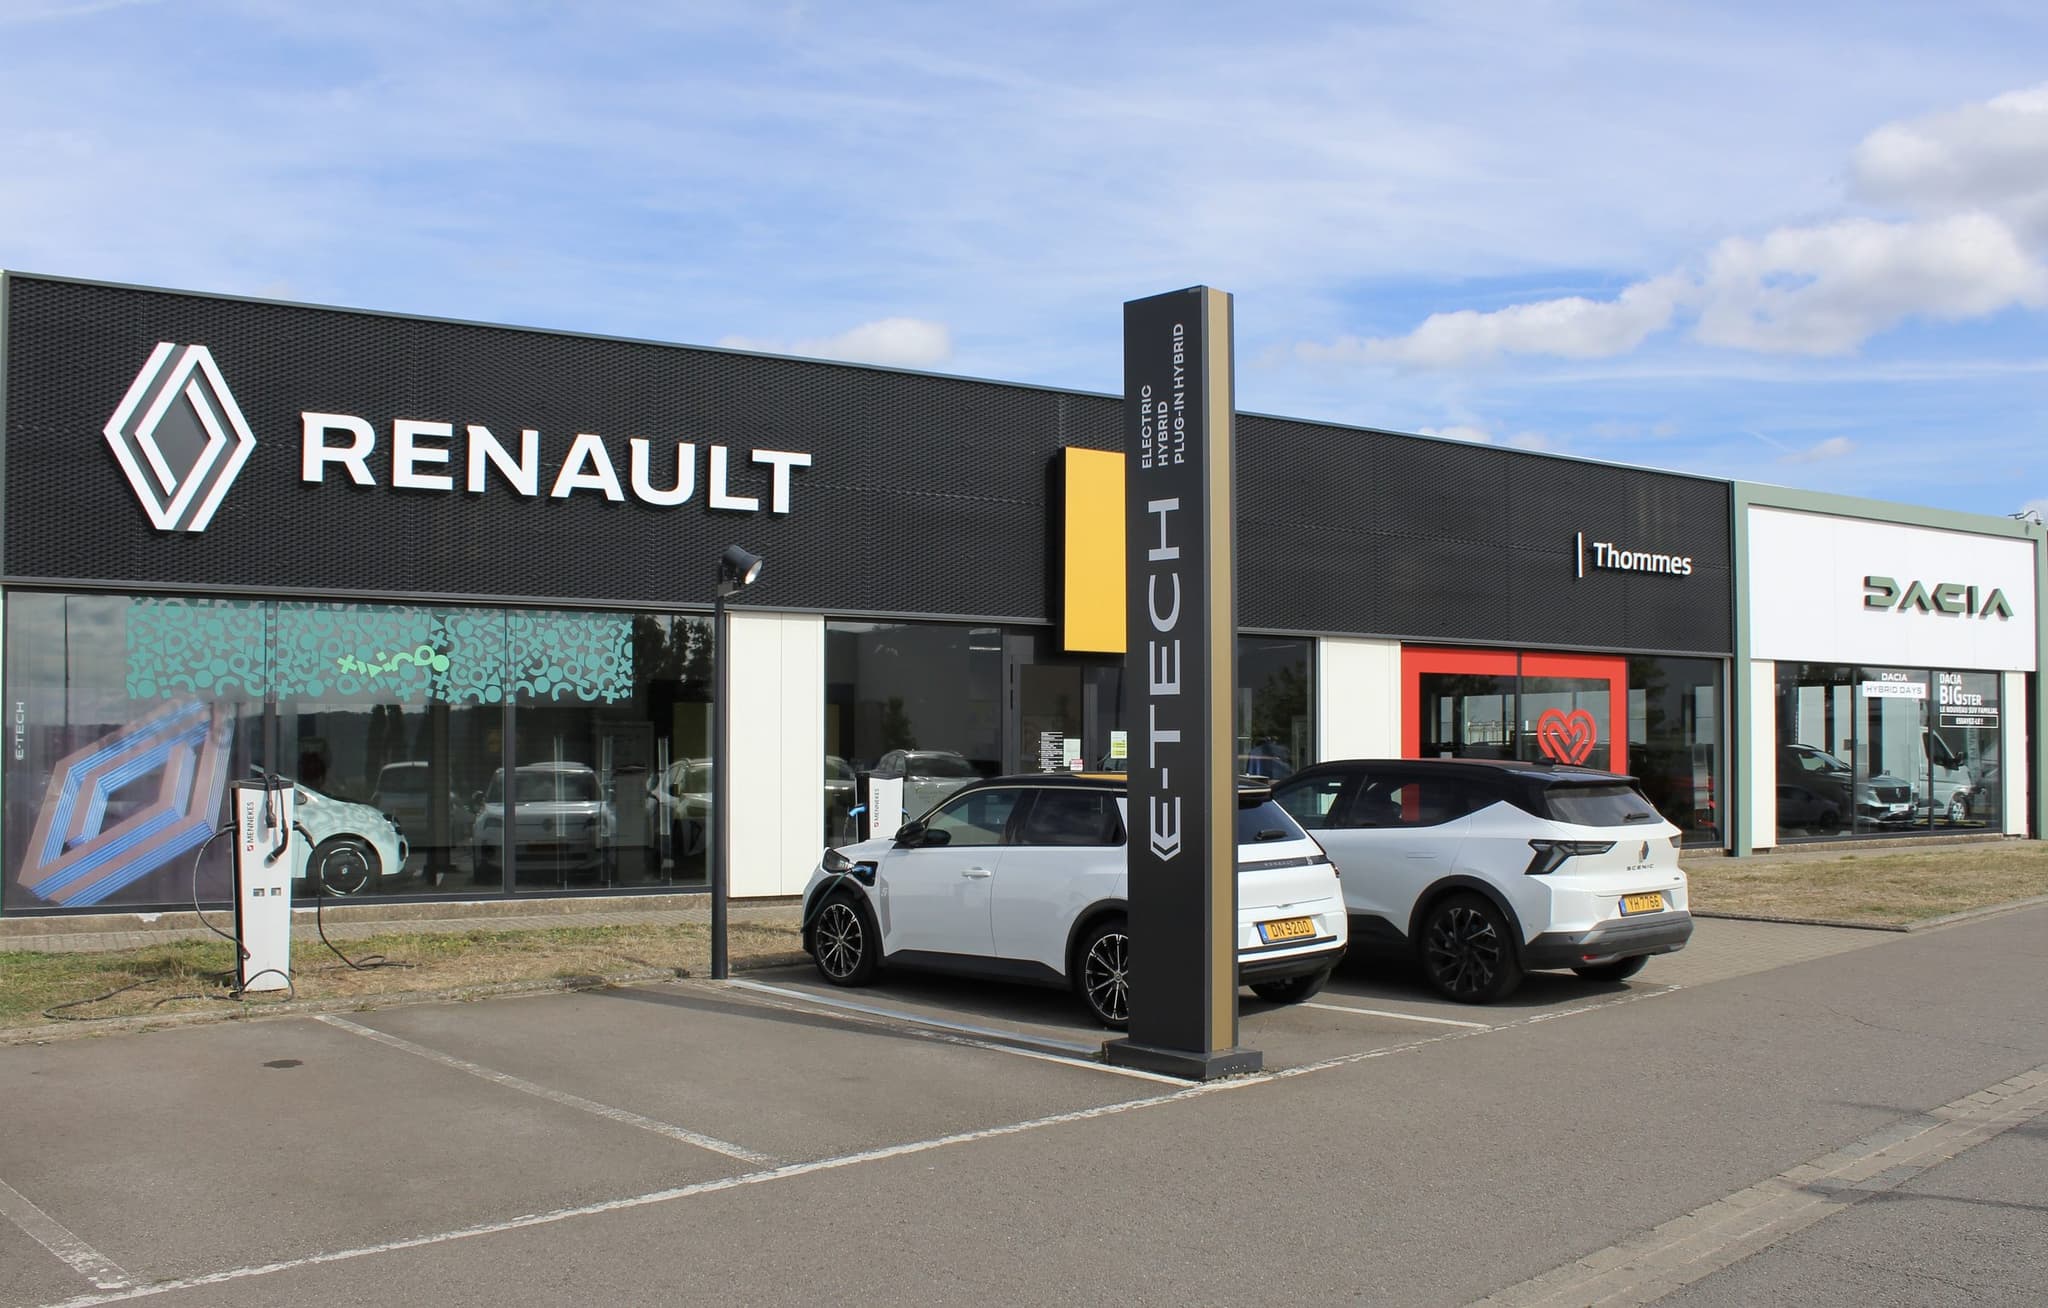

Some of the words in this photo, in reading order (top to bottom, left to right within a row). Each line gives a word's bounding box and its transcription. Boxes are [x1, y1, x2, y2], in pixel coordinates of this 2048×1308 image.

[1173, 323, 1184, 389] HYBRID
[1141, 384, 1152, 468] ELECTRIC
[1157, 401, 1168, 466] HYBRID
[1174, 392, 1184, 464] PLUG-IN
[301, 411, 812, 514] RENAULT
[1593, 542, 1692, 575] Thommes
[1864, 576, 2015, 618] DACIA
[1148, 497, 1181, 862] E-TECH
[1866, 686, 1900, 694] HYBRID
[1881, 673, 1908, 682] DACIA
[1939, 673, 1962, 685] DACIA
[15, 702, 25, 761] E-TECH
[246, 801, 255, 844] MENNEKES
